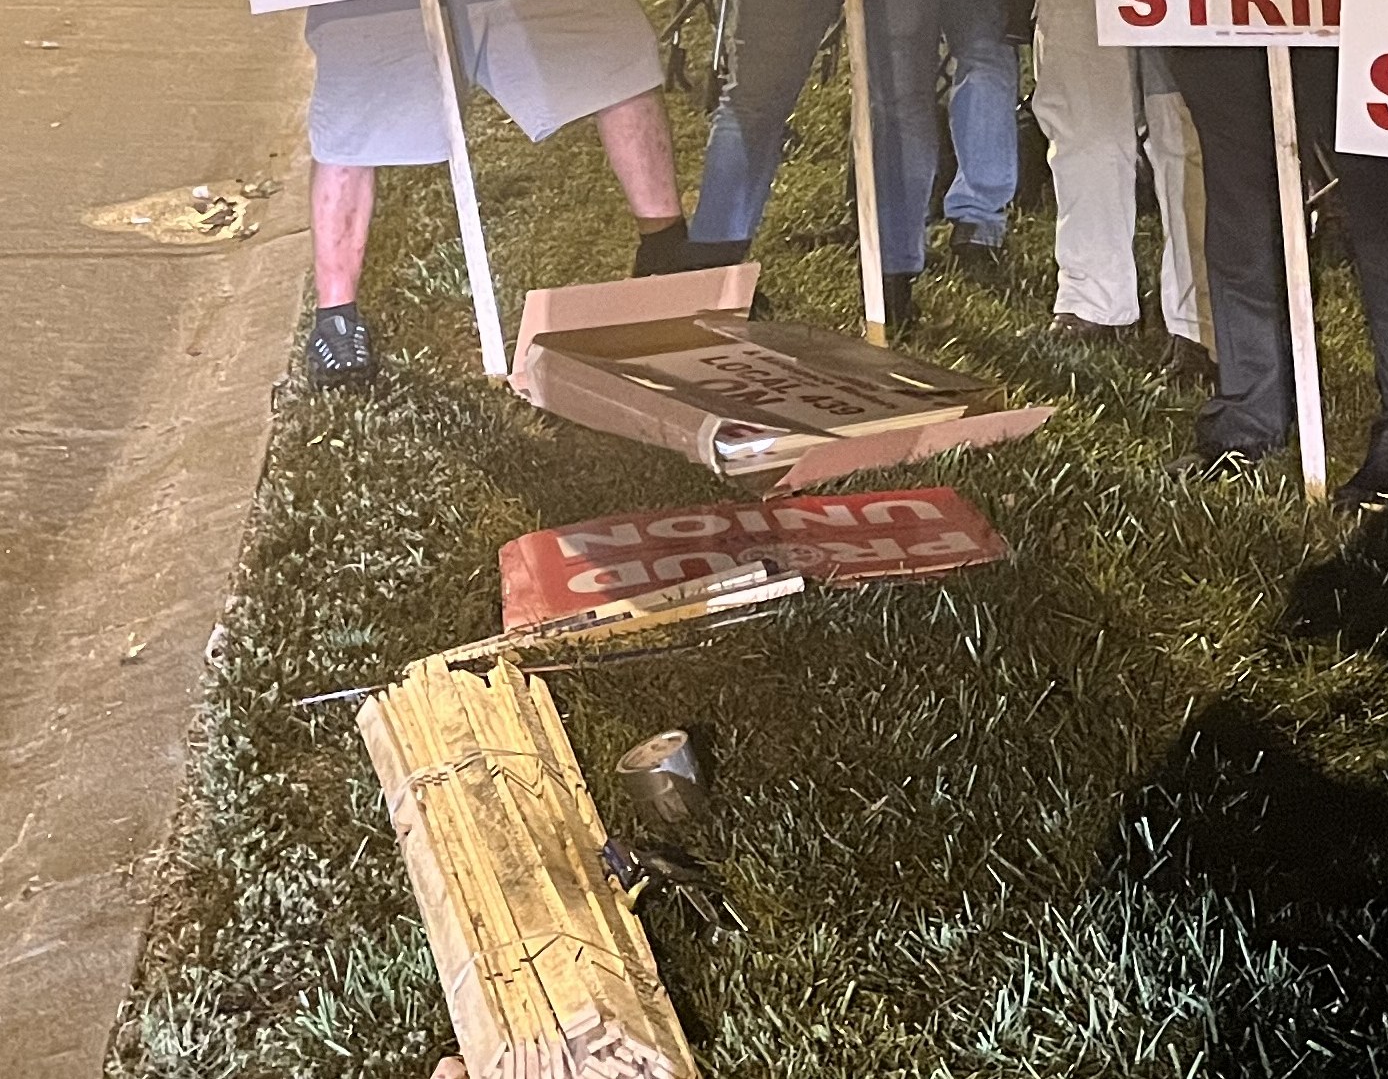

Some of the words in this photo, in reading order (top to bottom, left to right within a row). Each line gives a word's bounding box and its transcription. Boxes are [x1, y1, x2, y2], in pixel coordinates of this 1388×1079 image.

[698, 355, 801, 394] LOCAL
[800, 394, 866, 415] 439
[556, 499, 945, 558] UNION
